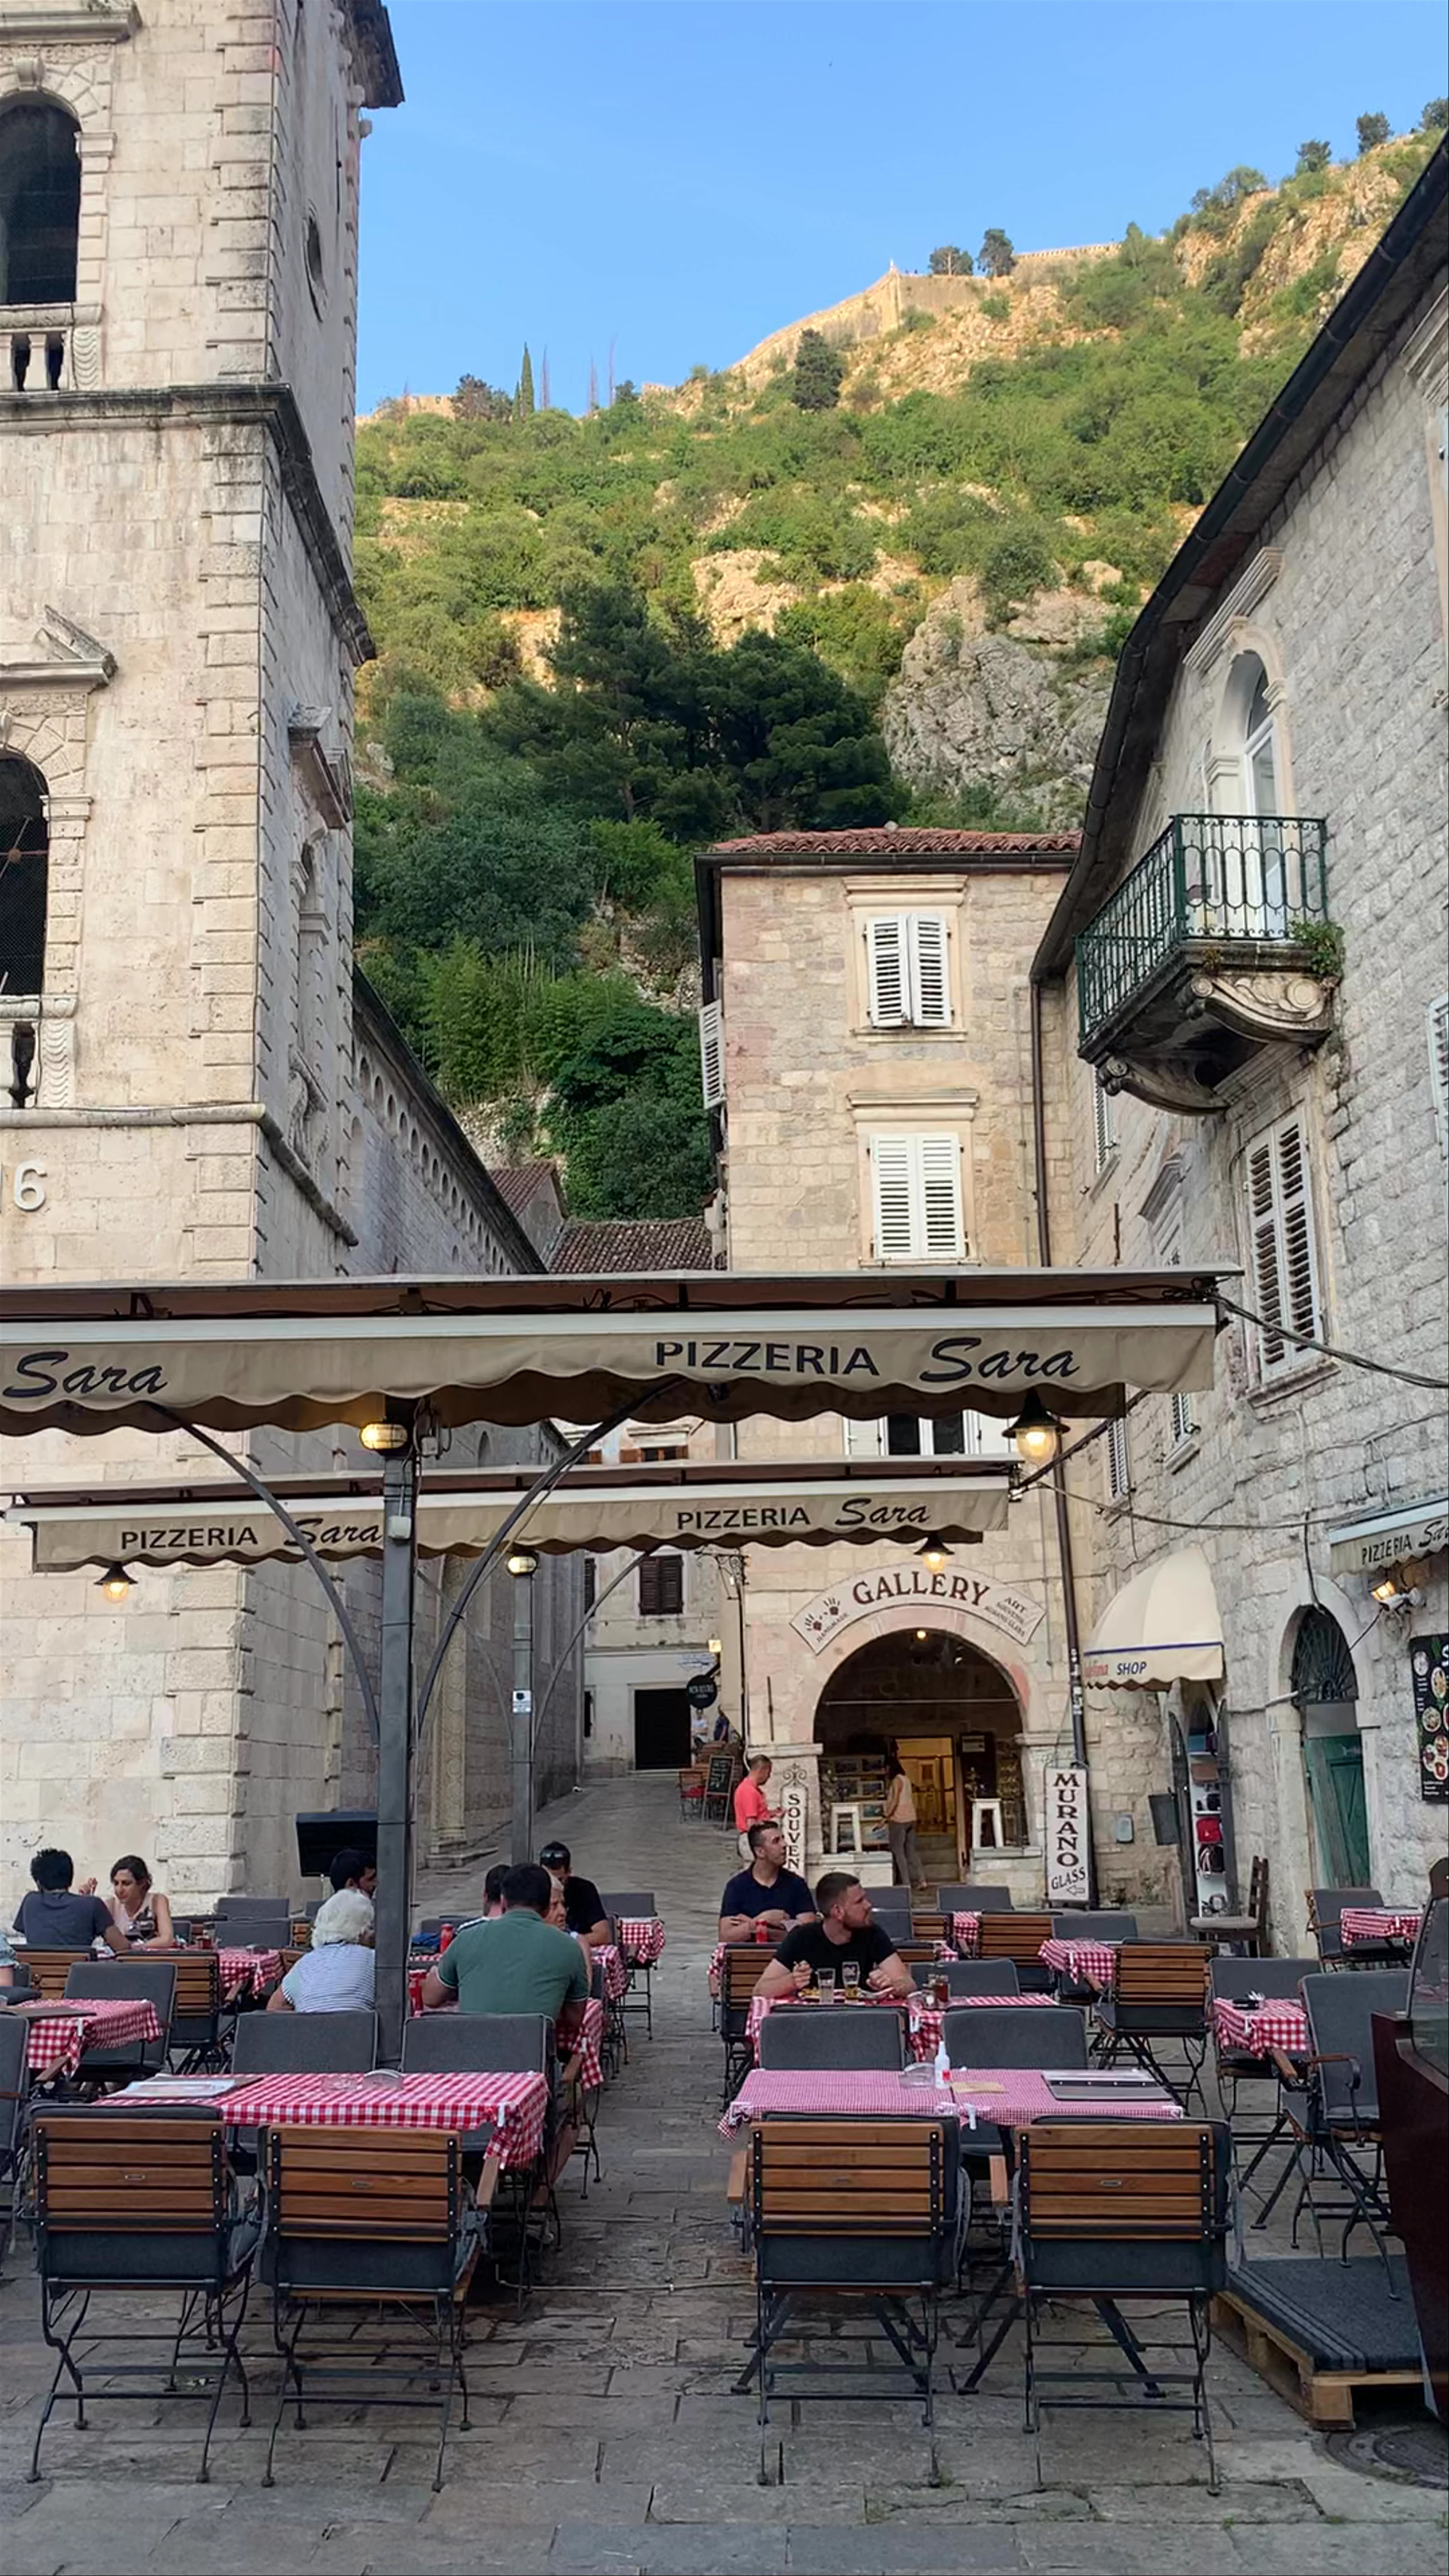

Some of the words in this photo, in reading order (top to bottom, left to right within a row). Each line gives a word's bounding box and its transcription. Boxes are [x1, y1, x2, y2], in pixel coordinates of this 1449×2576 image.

[14, 1160, 46, 1212] 6
[3, 1351, 168, 1398] Sara
[656, 1341, 880, 1376] PIZZERIA
[920, 1337, 1080, 1382] Sara
[678, 1507, 810, 1529] PIZZERIA
[835, 1498, 931, 1526] Sara
[122, 1527, 258, 1550] PIZZERIA
[284, 1518, 383, 1546] Sara
[1362, 1533, 1412, 1565] PIZZERIA
[852, 1570, 991, 1606] GALLERY
[1117, 1661, 1147, 1675] SHOP
[787, 1793, 801, 1869] SOUVEN
[1053, 1773, 1080, 1867] MURANO
[1051, 1867, 1086, 1890] GLASS
